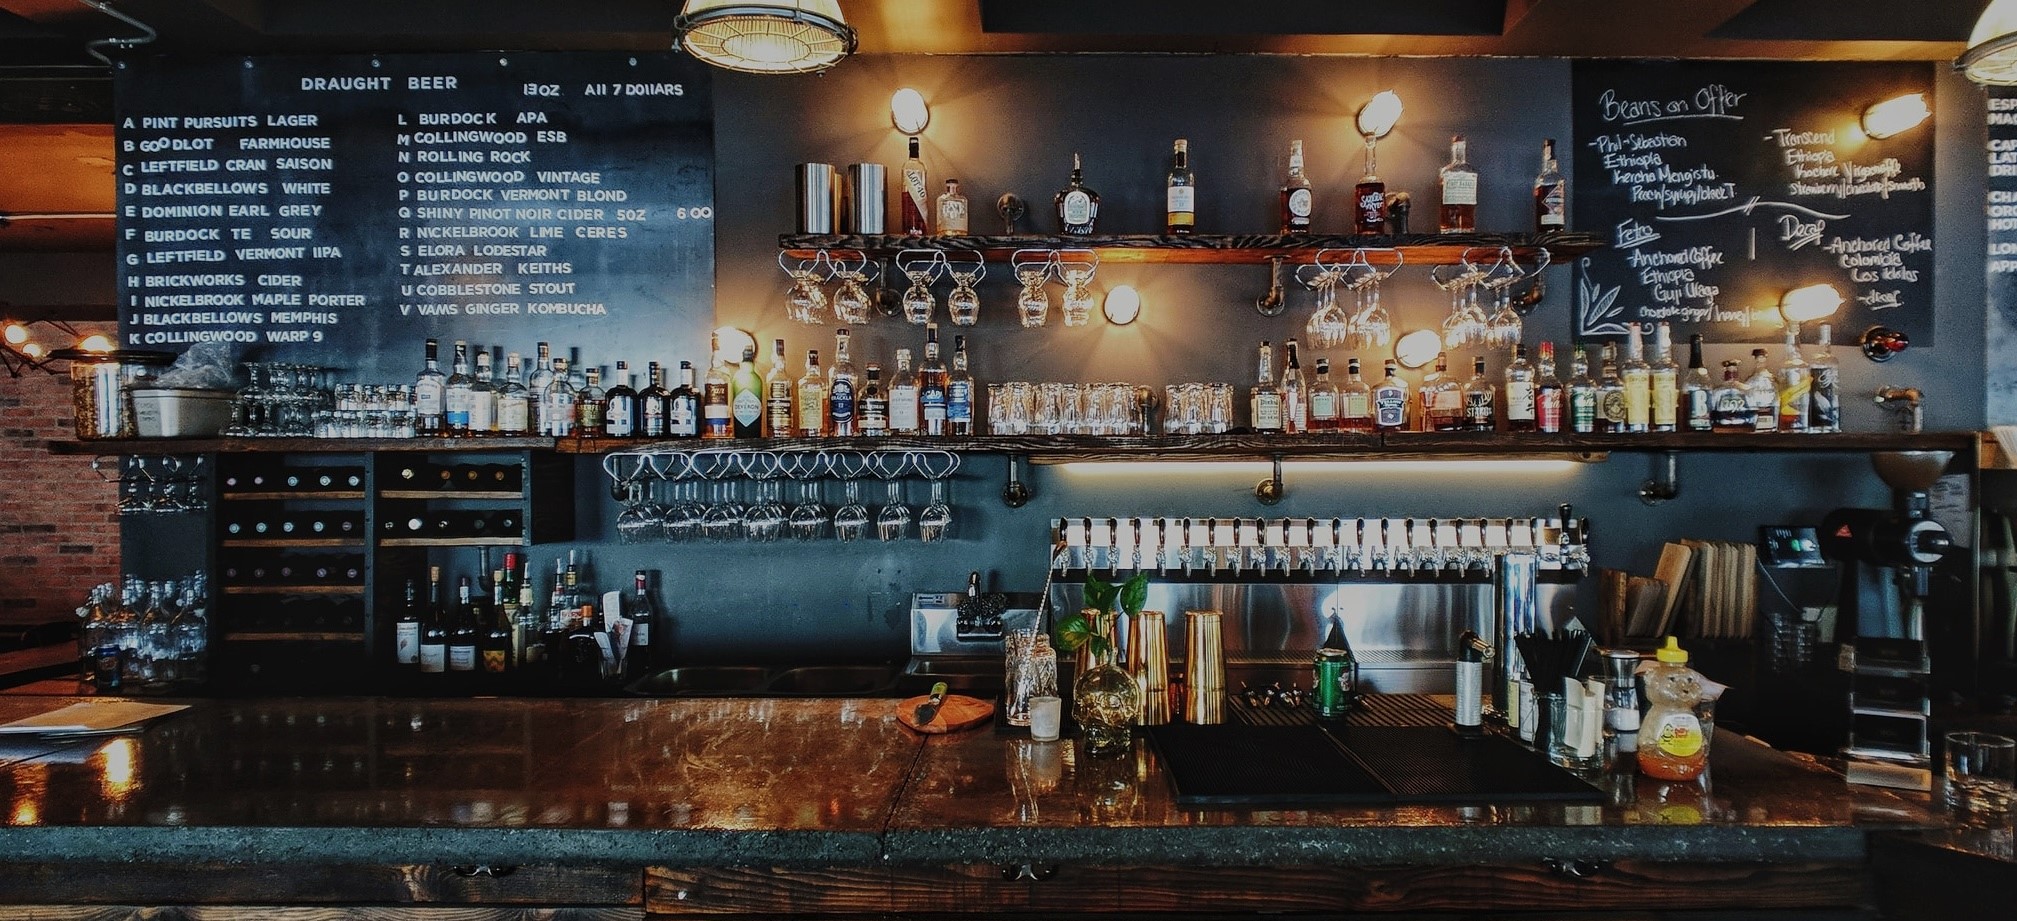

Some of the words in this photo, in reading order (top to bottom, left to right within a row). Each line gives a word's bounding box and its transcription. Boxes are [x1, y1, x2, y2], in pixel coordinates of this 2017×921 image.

[302, 77, 391, 90] DRAUGHT
[408, 76, 457, 89] BEER
[613, 84, 621, 95] 7
[1599, 89, 1661, 120] Beans
[1667, 101, 1689, 112] on
[1696, 84, 1747, 115] Offer
[123, 118, 135, 128] A
[143, 117, 178, 128] PINT
[184, 116, 257, 128] PURSUITS
[268, 115, 318, 126] LAGER
[398, 114, 407, 125] L
[420, 113, 496, 125] BURDOCK
[516, 112, 548, 123] APA
[124, 141, 134, 151] B
[240, 137, 330, 150] FARMHOUSE
[397, 134, 410, 146] M
[414, 131, 527, 144] COLLINGWOOD
[537, 131, 567, 142] ESB
[398, 151, 409, 163] N
[418, 151, 483, 162] ROLLING
[491, 151, 531, 163] ROCK
[1604, 153, 1662, 169] Ethiopia
[1785, 148, 1835, 165] Ethiopia
[123, 165, 133, 176] C
[141, 160, 219, 172] LEFTFIELD
[226, 159, 266, 171] CRAN
[276, 158, 332, 170] SAISON
[397, 172, 410, 183] O
[415, 171, 525, 183] COLLINGWOOD
[537, 171, 600, 184] VINTAGE
[125, 183, 136, 194] D
[142, 183, 268, 195] BLACKBELLOWS
[282, 183, 330, 194] WHITE
[399, 190, 409, 201] P
[417, 189, 493, 201] BURDOCK
[501, 189, 570, 200] VERMONT
[577, 190, 627, 201] BLOND
[125, 206, 136, 217] E
[142, 205, 222, 218] DOMINION
[229, 205, 270, 216] EARL
[279, 205, 322, 217] GREY
[399, 207, 411, 218] Q
[417, 207, 463, 219] SHINY
[470, 208, 511, 220] PINOT
[516, 209, 553, 220] NOIR
[557, 209, 604, 220] CIDER
[125, 229, 136, 240] F
[145, 229, 220, 242] BURDOCK
[231, 228, 251, 239] TE
[271, 228, 312, 239] SOUR
[399, 228, 410, 238] R
[417, 227, 518, 238] NICKELBROOK
[530, 227, 563, 238] LIME
[576, 227, 627, 238] CERES
[1779, 215, 1826, 245] Decaf
[1892, 232, 1932, 253] Coffee
[127, 254, 139, 265] G
[147, 250, 226, 263] LEFTFIELD
[235, 247, 305, 260] VERMONT
[313, 247, 342, 258] IIPA
[400, 245, 411, 256] S
[418, 245, 465, 256] ELORA
[474, 245, 547, 256] LODESTAR
[1840, 252, 1903, 267] Colombia
[400, 264, 410, 274] T
[414, 263, 502, 275] ALEXANDER
[518, 263, 572, 274] KEITHS
[1851, 268, 1880, 282] Los
[128, 276, 139, 287] H
[145, 274, 245, 287] BRICKWORKS
[258, 275, 302, 286] CIDER
[1641, 267, 1695, 285] Ethiopia
[401, 285, 413, 296] U
[417, 284, 520, 296] COBBLESTONE
[529, 283, 575, 294] STOUT
[145, 294, 244, 307] NICKELBROOK
[252, 294, 301, 305] MAPLE
[309, 294, 367, 306] PORTER
[400, 304, 411, 315] V
[465, 303, 519, 314] GINGER
[528, 303, 606, 314] KOMBUCHA
[130, 314, 138, 324] J
[144, 312, 263, 325] BLACKBELLOWS
[271, 312, 338, 324] MEMPHIS
[130, 334, 140, 344] K
[145, 331, 257, 344] COLLINGWOOD
[266, 331, 309, 342] WARP
[313, 331, 323, 342] 9
